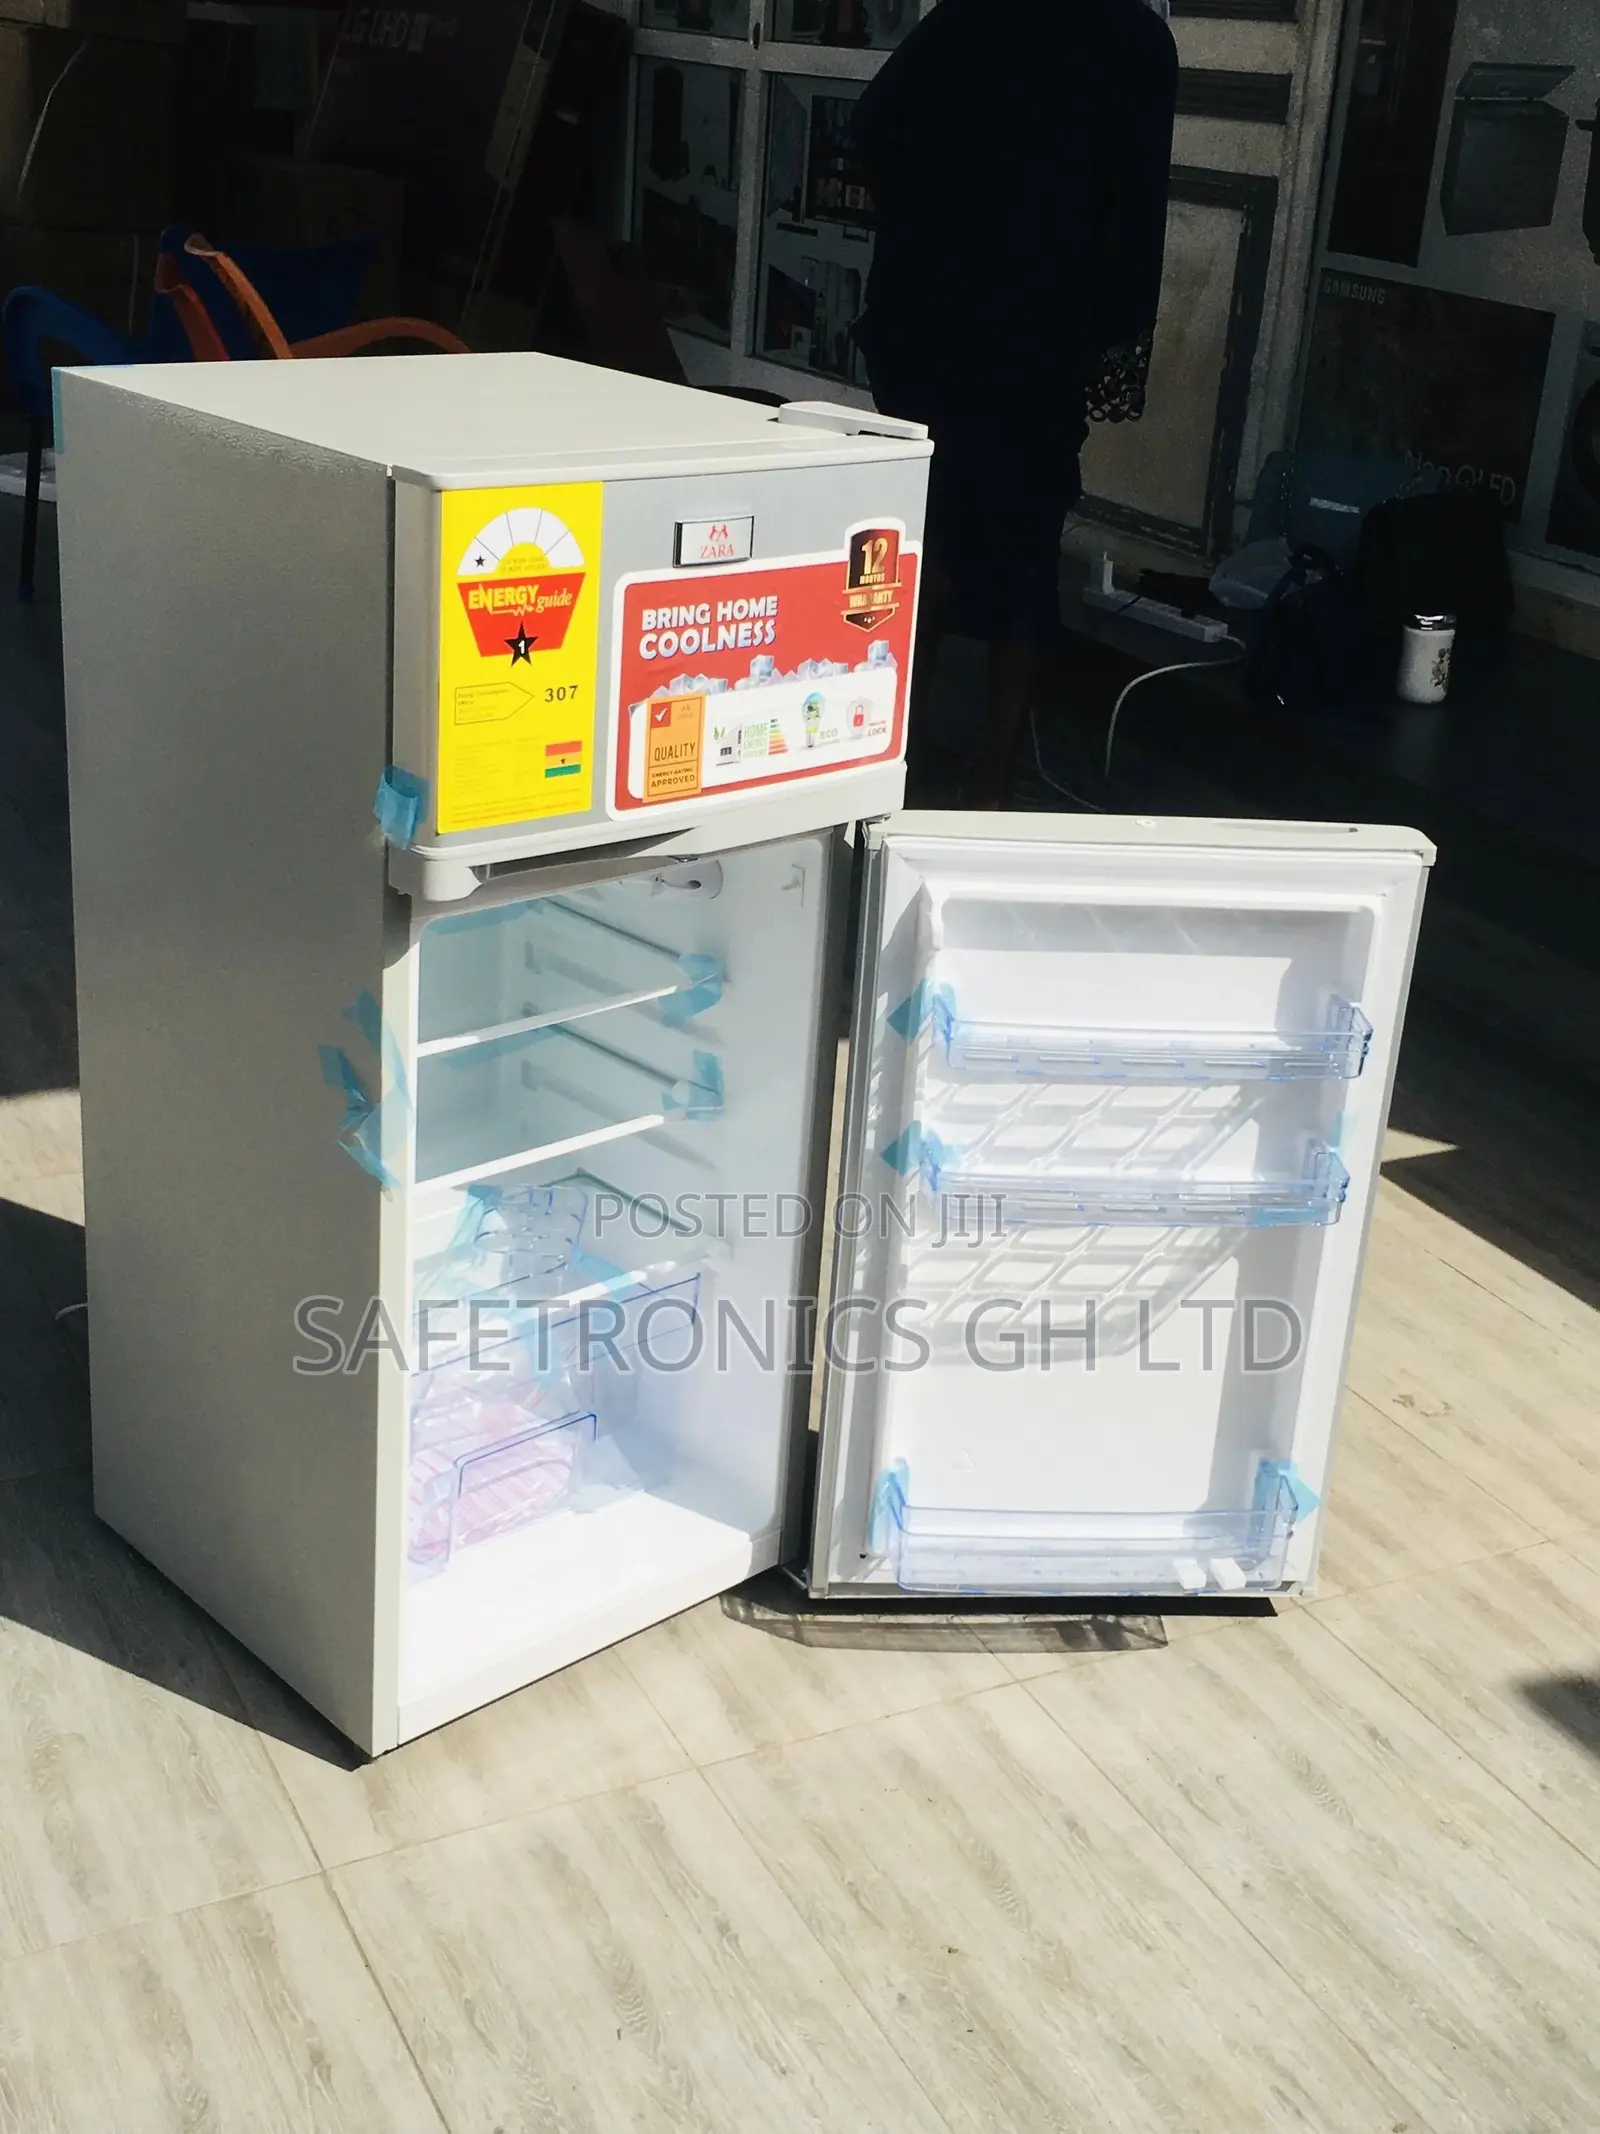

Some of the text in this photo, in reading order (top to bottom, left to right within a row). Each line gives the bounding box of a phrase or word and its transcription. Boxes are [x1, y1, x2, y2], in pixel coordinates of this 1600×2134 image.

[1322, 277, 1386, 304] SAMSUNG
[700, 543, 735, 559] ZARA
[862, 537, 888, 575] 12
[468, 584, 573, 615] ENERGY guide
[641, 595, 779, 632] BRING HOME
[518, 640, 526, 655] 1
[638, 619, 777, 661] COOLNESS
[544, 685, 579, 703] 307
[819, 728, 839, 740] ECO
[867, 726, 888, 737] LOCK
[654, 742, 696, 762] QUALITY
[651, 774, 696, 788] APPROVED
